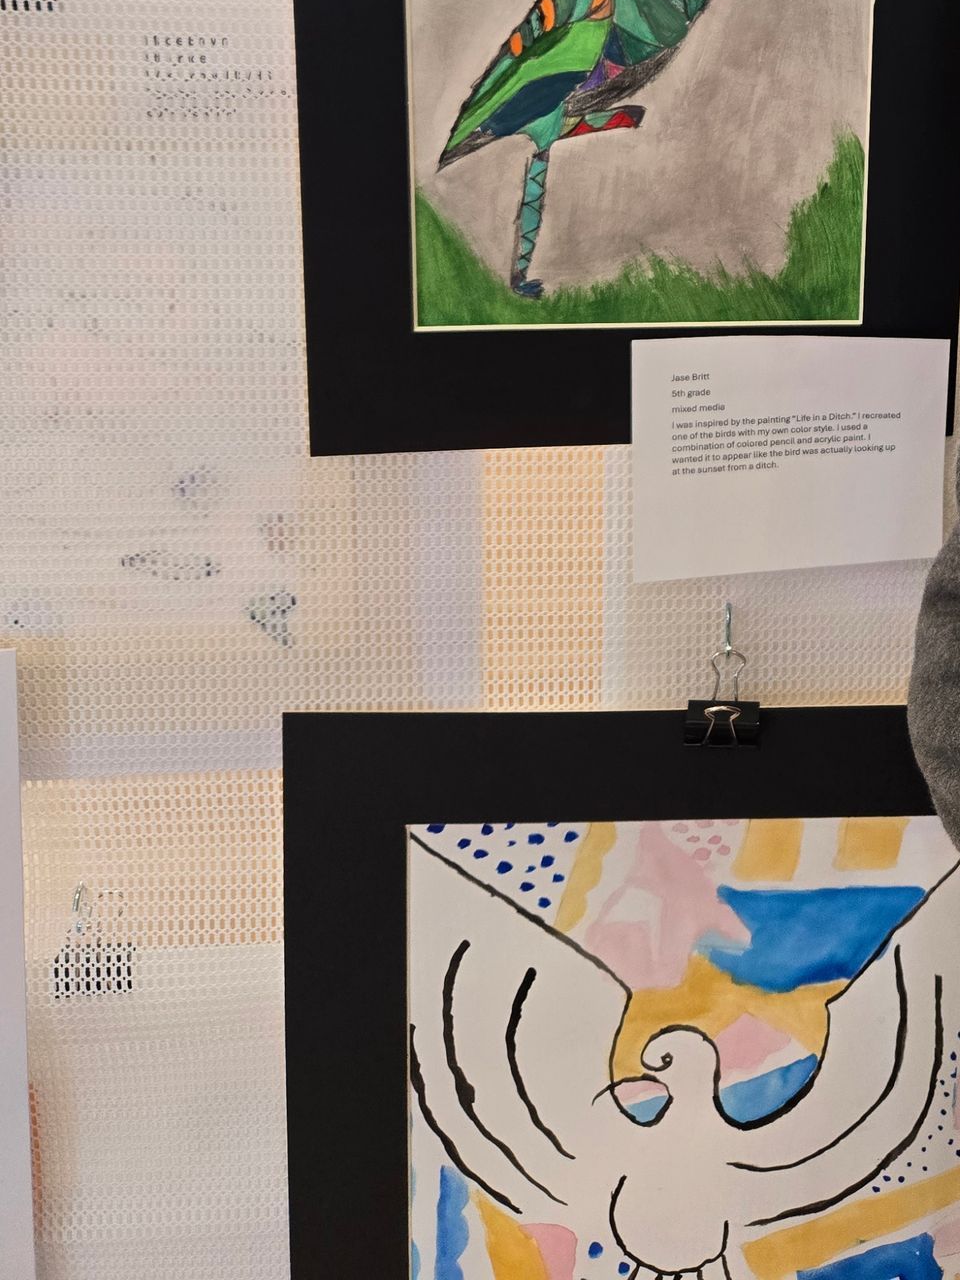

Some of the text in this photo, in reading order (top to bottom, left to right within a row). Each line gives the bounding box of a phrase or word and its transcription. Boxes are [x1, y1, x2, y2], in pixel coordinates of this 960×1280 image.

[671, 373, 710, 382] Jase Britt
[671, 388, 711, 399] 5th grade
[671, 403, 726, 413] mixed media
[695, 418, 729, 428] inspired
[730, 418, 741, 427] by
[742, 417, 756, 426] the
[757, 415, 791, 426] painting
[812, 413, 820, 421] in
[861, 411, 902, 420] recreated
[671, 433, 688, 441] one
[689, 432, 699, 440] of
[699, 431, 714, 439] the
[715, 428, 737, 438] birds
[738, 428, 756, 437] with
[757, 429, 770, 437] my
[771, 427, 790, 435] own
[790, 424, 812, 433] color
[813, 424, 836, 433] style.
[841, 423, 862, 431] used
[671, 442, 725, 453] combination
[726, 439, 736, 449] of
[736, 438, 769, 448] colored
[769, 436, 796, 447] pencil
[796, 435, 813, 444] and
[814, 433, 842, 444] acrylic
[842, 433, 867, 443] paint.
[671, 442, 896, 464] wanted it to appear like the bird was actually looking up
[671, 468, 681, 476] at
[682, 465, 697, 475] the
[697, 464, 726, 474] sunset
[727, 461, 748, 472] from
[748, 463, 755, 471] a
